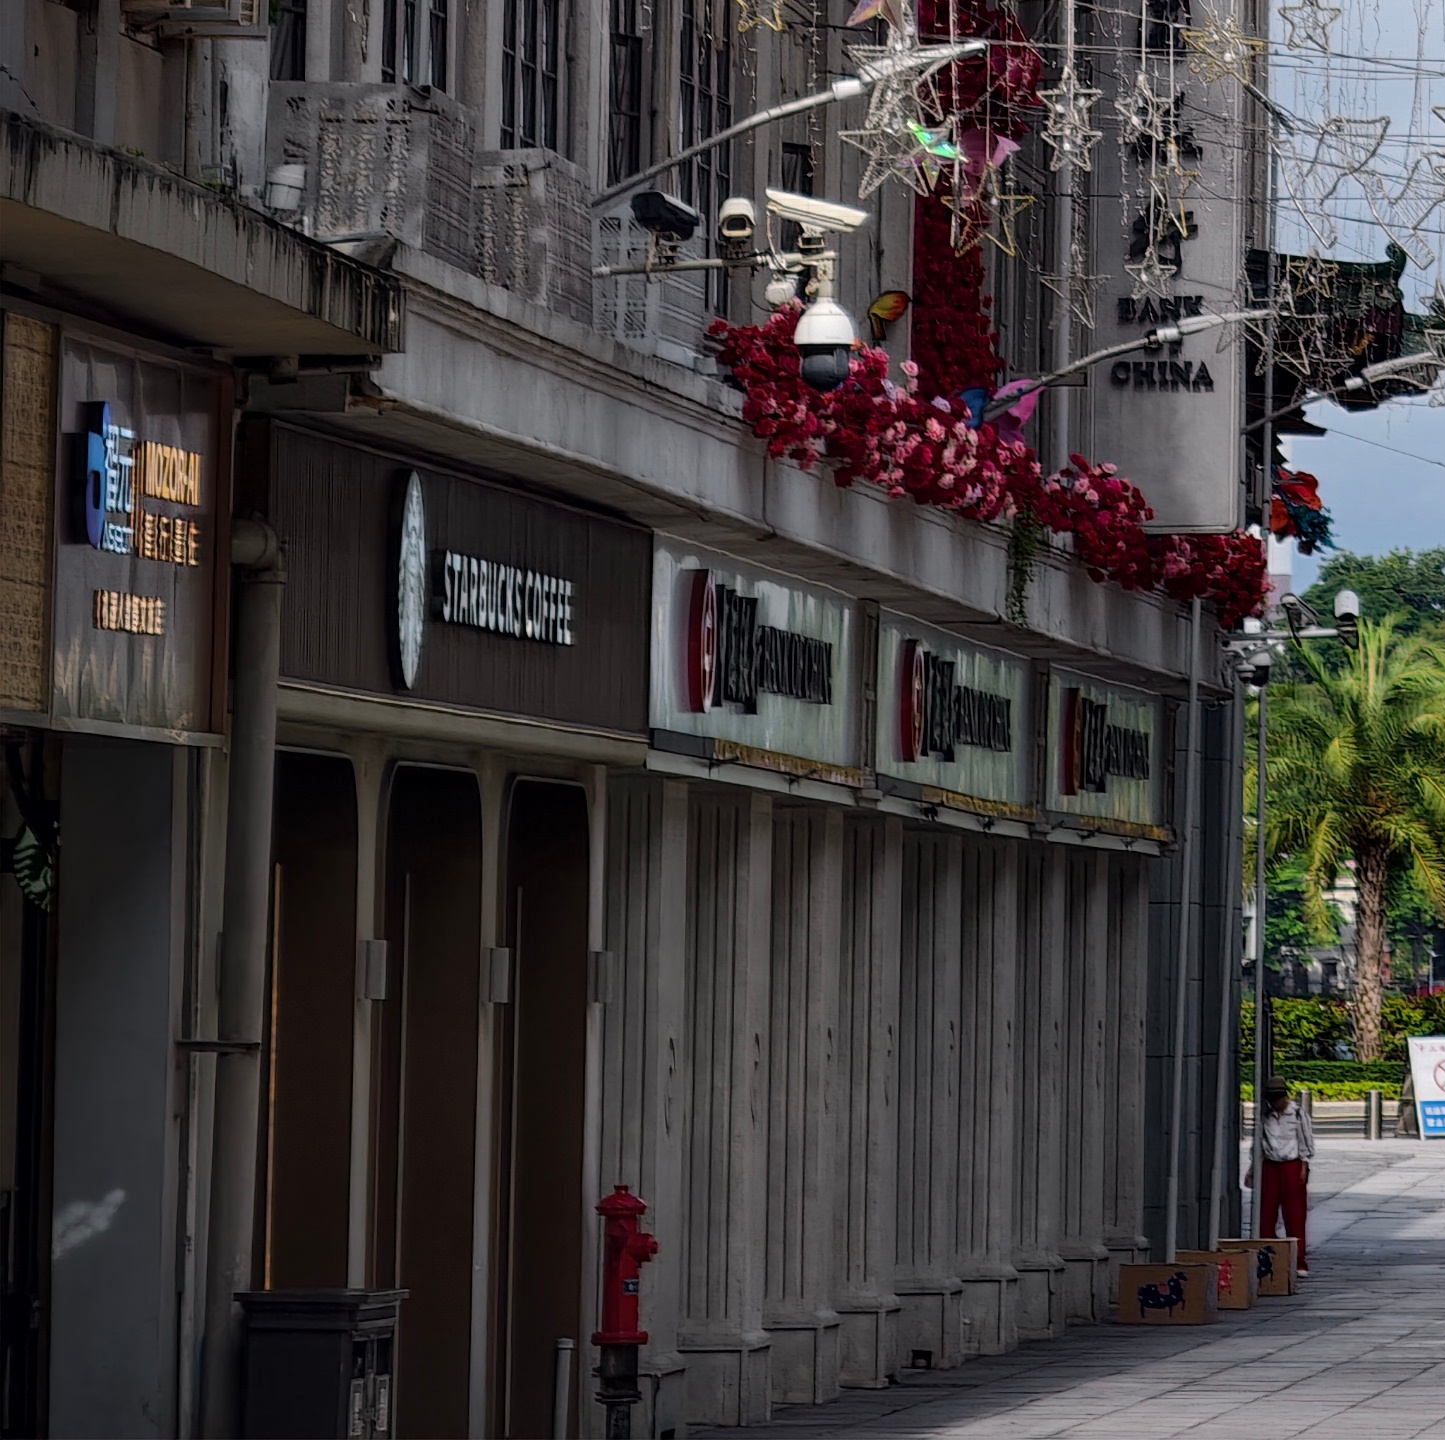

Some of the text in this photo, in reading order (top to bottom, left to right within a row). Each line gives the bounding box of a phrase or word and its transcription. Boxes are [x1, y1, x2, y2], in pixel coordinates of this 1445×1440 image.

[1116, 295, 1204, 324] BANK
[1110, 360, 1214, 393] CHINA
[443, 549, 575, 647] STARBUCKS COFFEE
